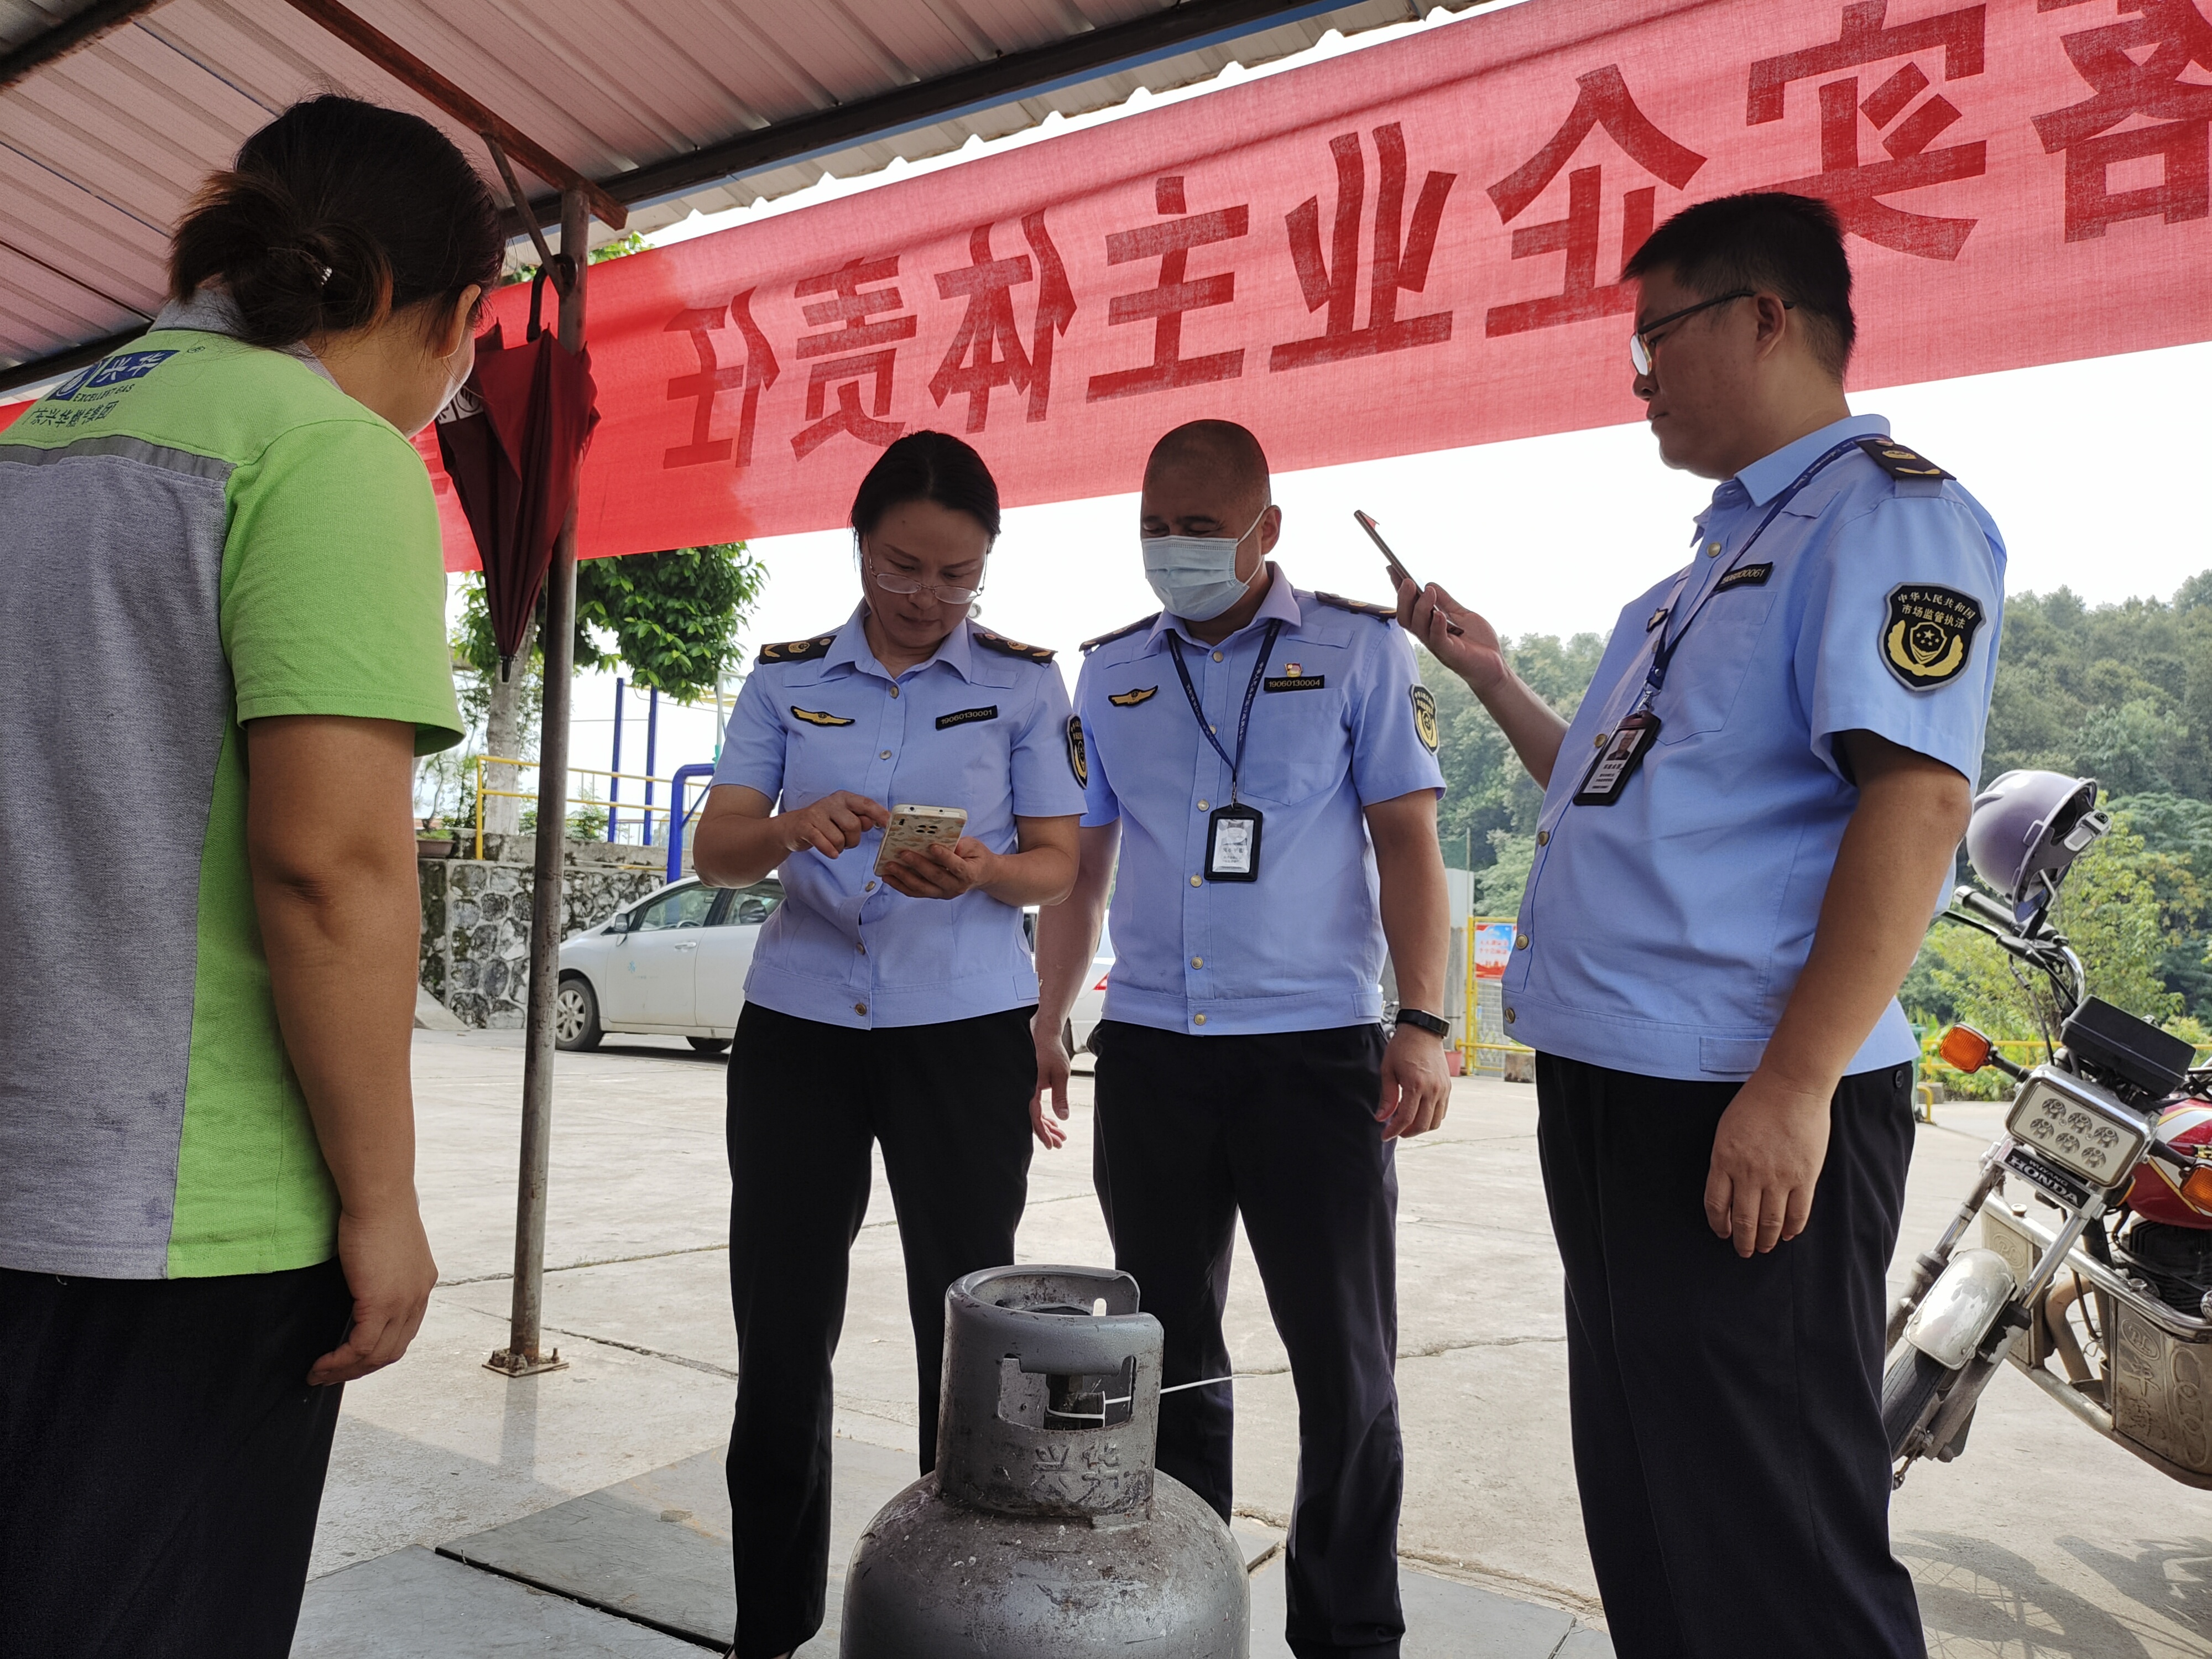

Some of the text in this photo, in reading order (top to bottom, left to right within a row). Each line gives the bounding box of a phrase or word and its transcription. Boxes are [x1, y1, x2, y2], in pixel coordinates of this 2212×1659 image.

[1897, 592, 1976, 620] 中华人民共和国
[1901, 604, 1966, 629] 市场监管执法
[1268, 679, 1321, 688] 19060130004
[941, 709, 992, 724] 19060130001
[2008, 1155, 2079, 1207] HONDA
[2029, 1160, 2069, 1187] WUYANG
